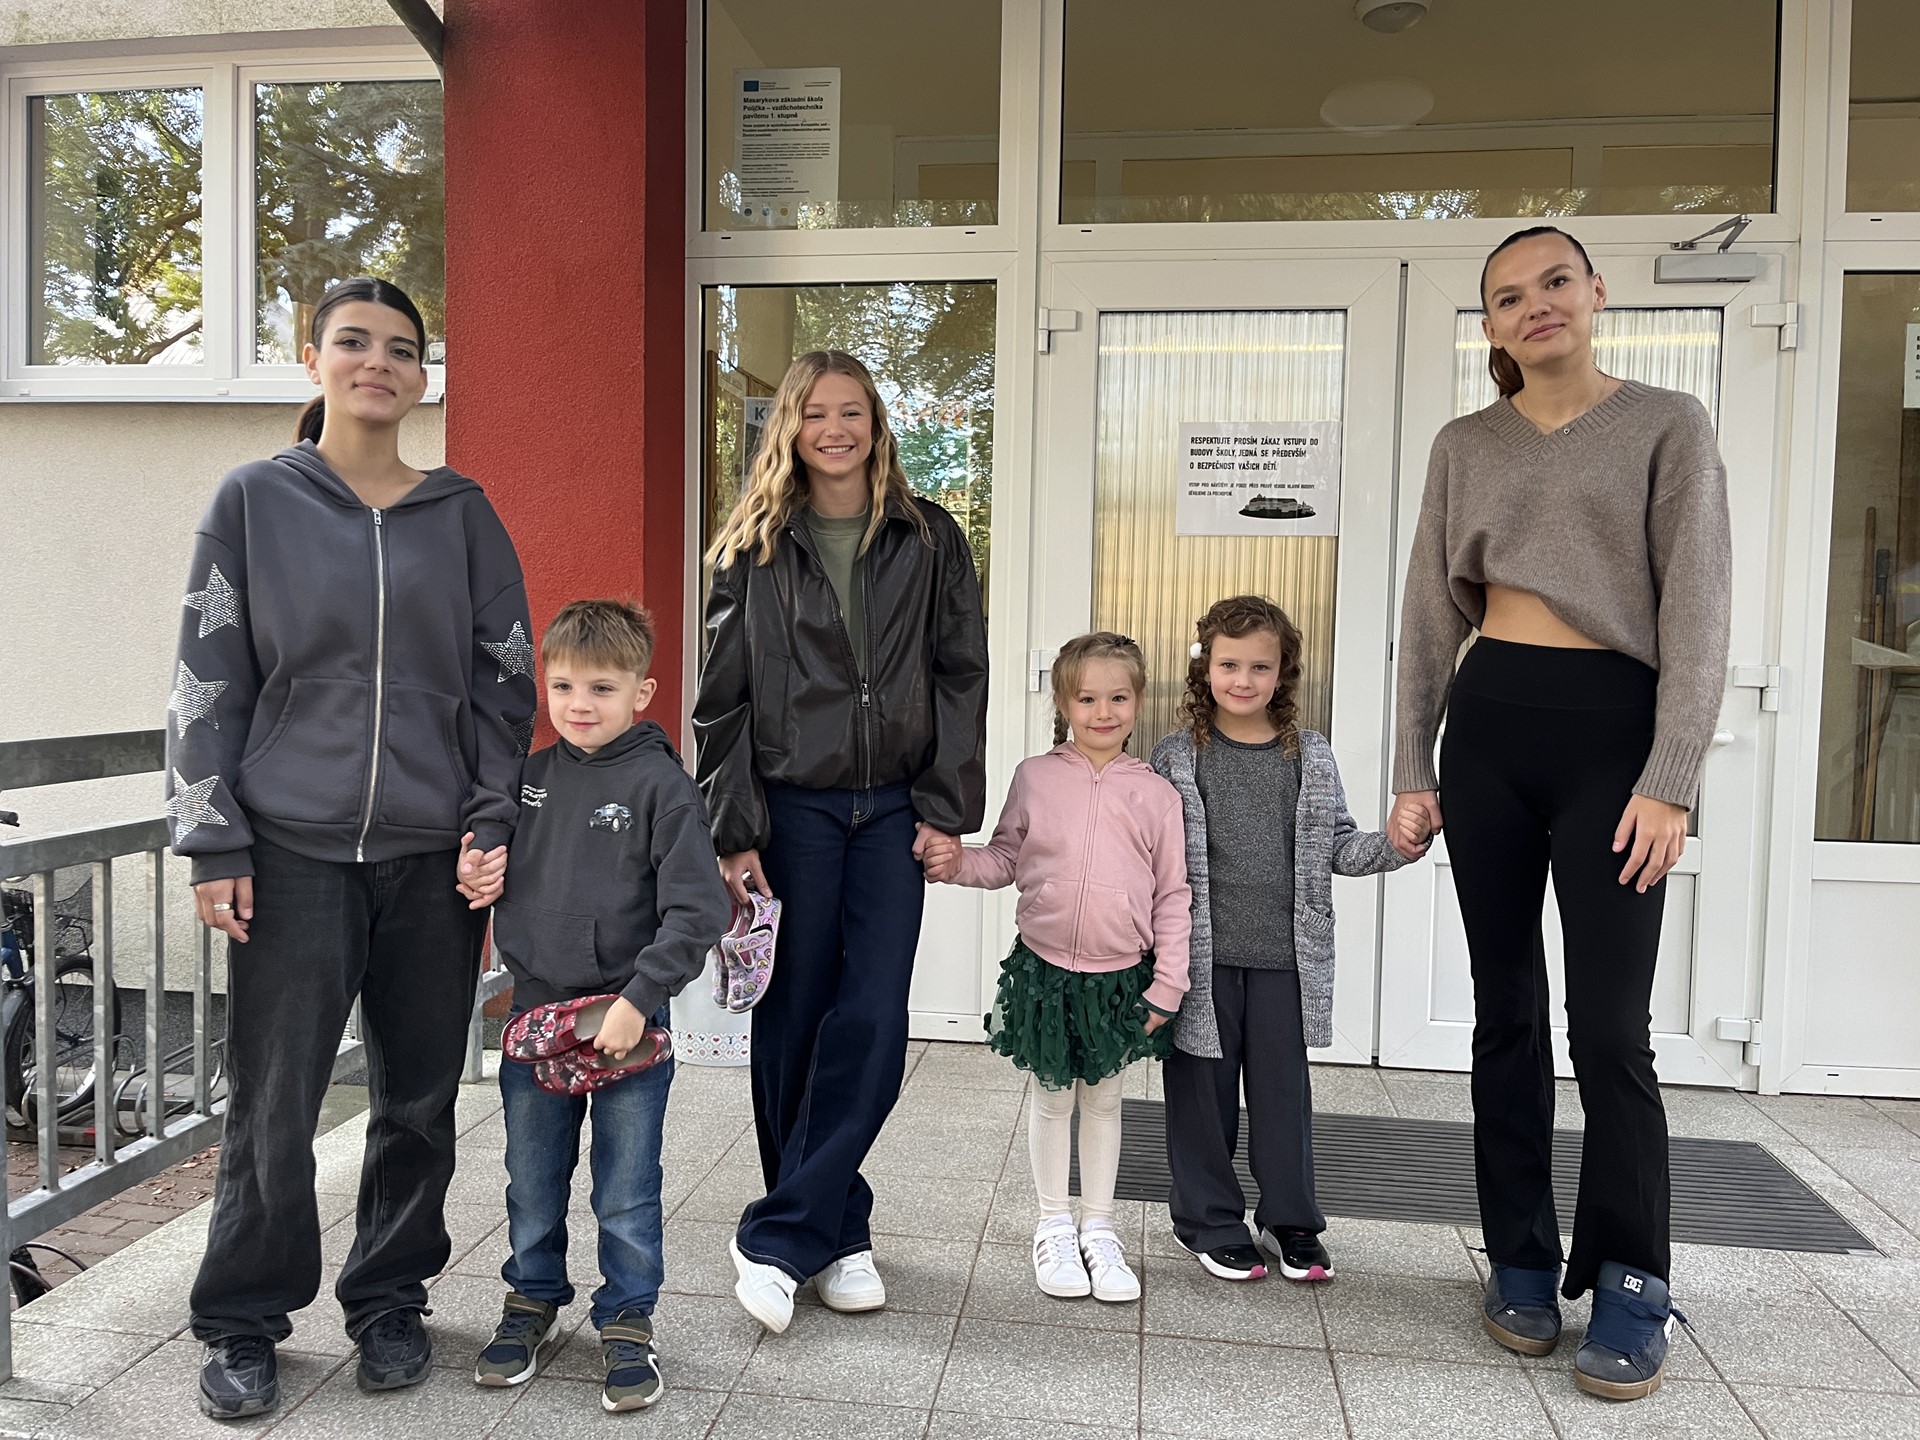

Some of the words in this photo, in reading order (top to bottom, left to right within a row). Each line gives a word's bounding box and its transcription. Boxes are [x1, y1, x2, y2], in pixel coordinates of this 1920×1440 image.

[1190, 436, 1231, 445] RESPEKTUJTE
[1234, 435, 1258, 445] PROSÍM
[1260, 435, 1281, 446] ZÁKAZ
[1283, 437, 1307, 446] VSTUPU
[1309, 437, 1319, 446] DO
[1190, 448, 1214, 457] BUDOVY
[1216, 446, 1237, 458] ŠKOLY,
[1238, 447, 1258, 457] JEDNÁ
[1260, 449, 1269, 457] SE
[1271, 447, 1307, 458] PŘEDEVŠÍM
[1189, 461, 1195, 470] O
[1197, 460, 1235, 470] BEZPEČNOST
[1238, 460, 1260, 471] VAŠICH
